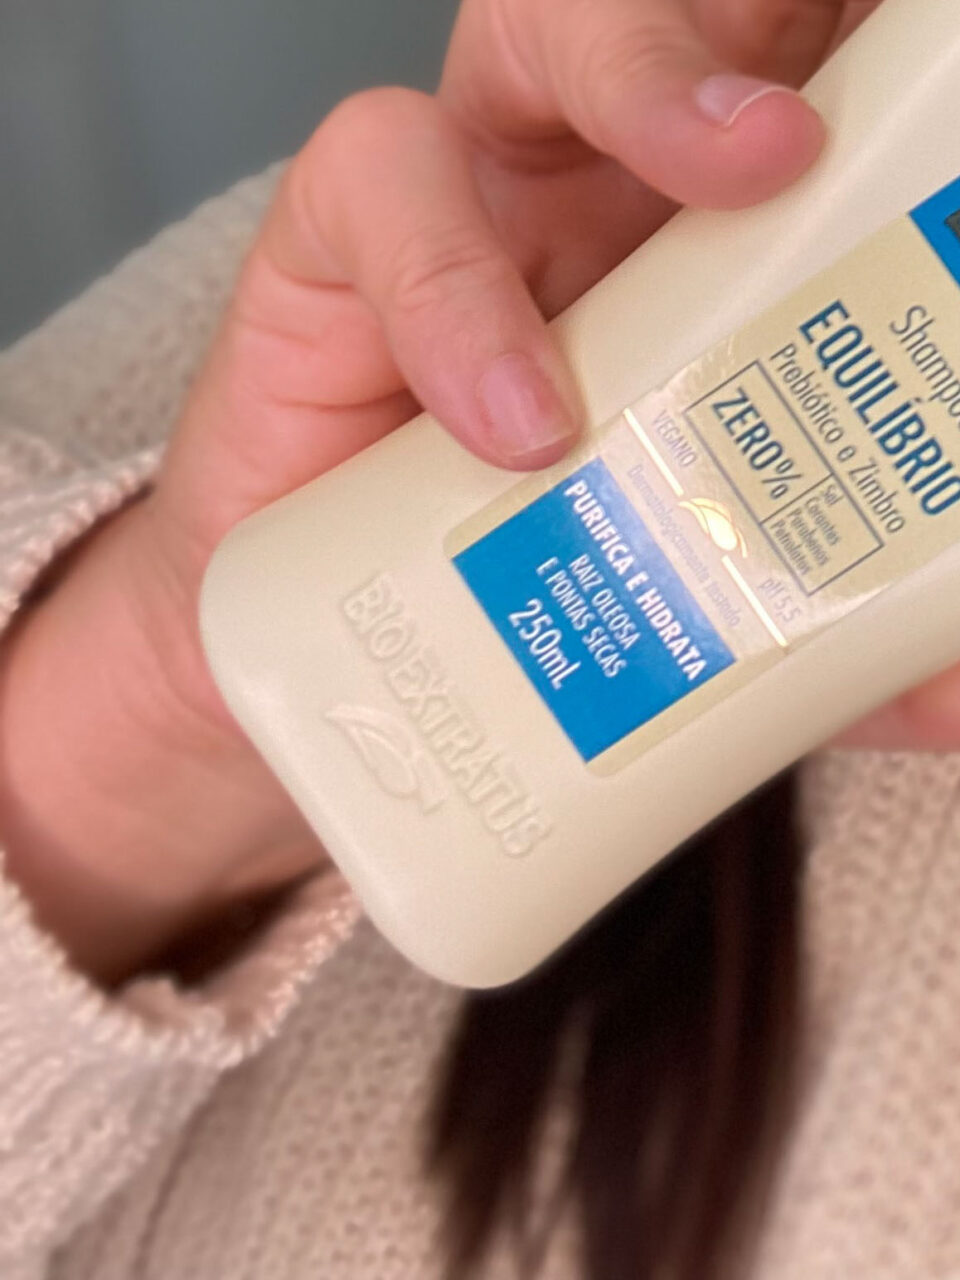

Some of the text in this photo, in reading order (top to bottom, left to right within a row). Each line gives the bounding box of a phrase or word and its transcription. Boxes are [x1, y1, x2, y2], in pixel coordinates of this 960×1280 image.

[651, 409, 698, 468] VEGANO
[711, 387, 804, 501] ZERO%
[769, 342, 906, 535] Prebiótico e Zimbro
[787, 507, 831, 567] Parabenos
[820, 484, 840, 507] Sal
[535, 556, 627, 679] E PONTAS SECAS
[564, 479, 708, 682] PURIFICA E HIDRATA
[568, 553, 642, 652] RAIZ OLEOSA
[507, 598, 582, 691] 250mL
